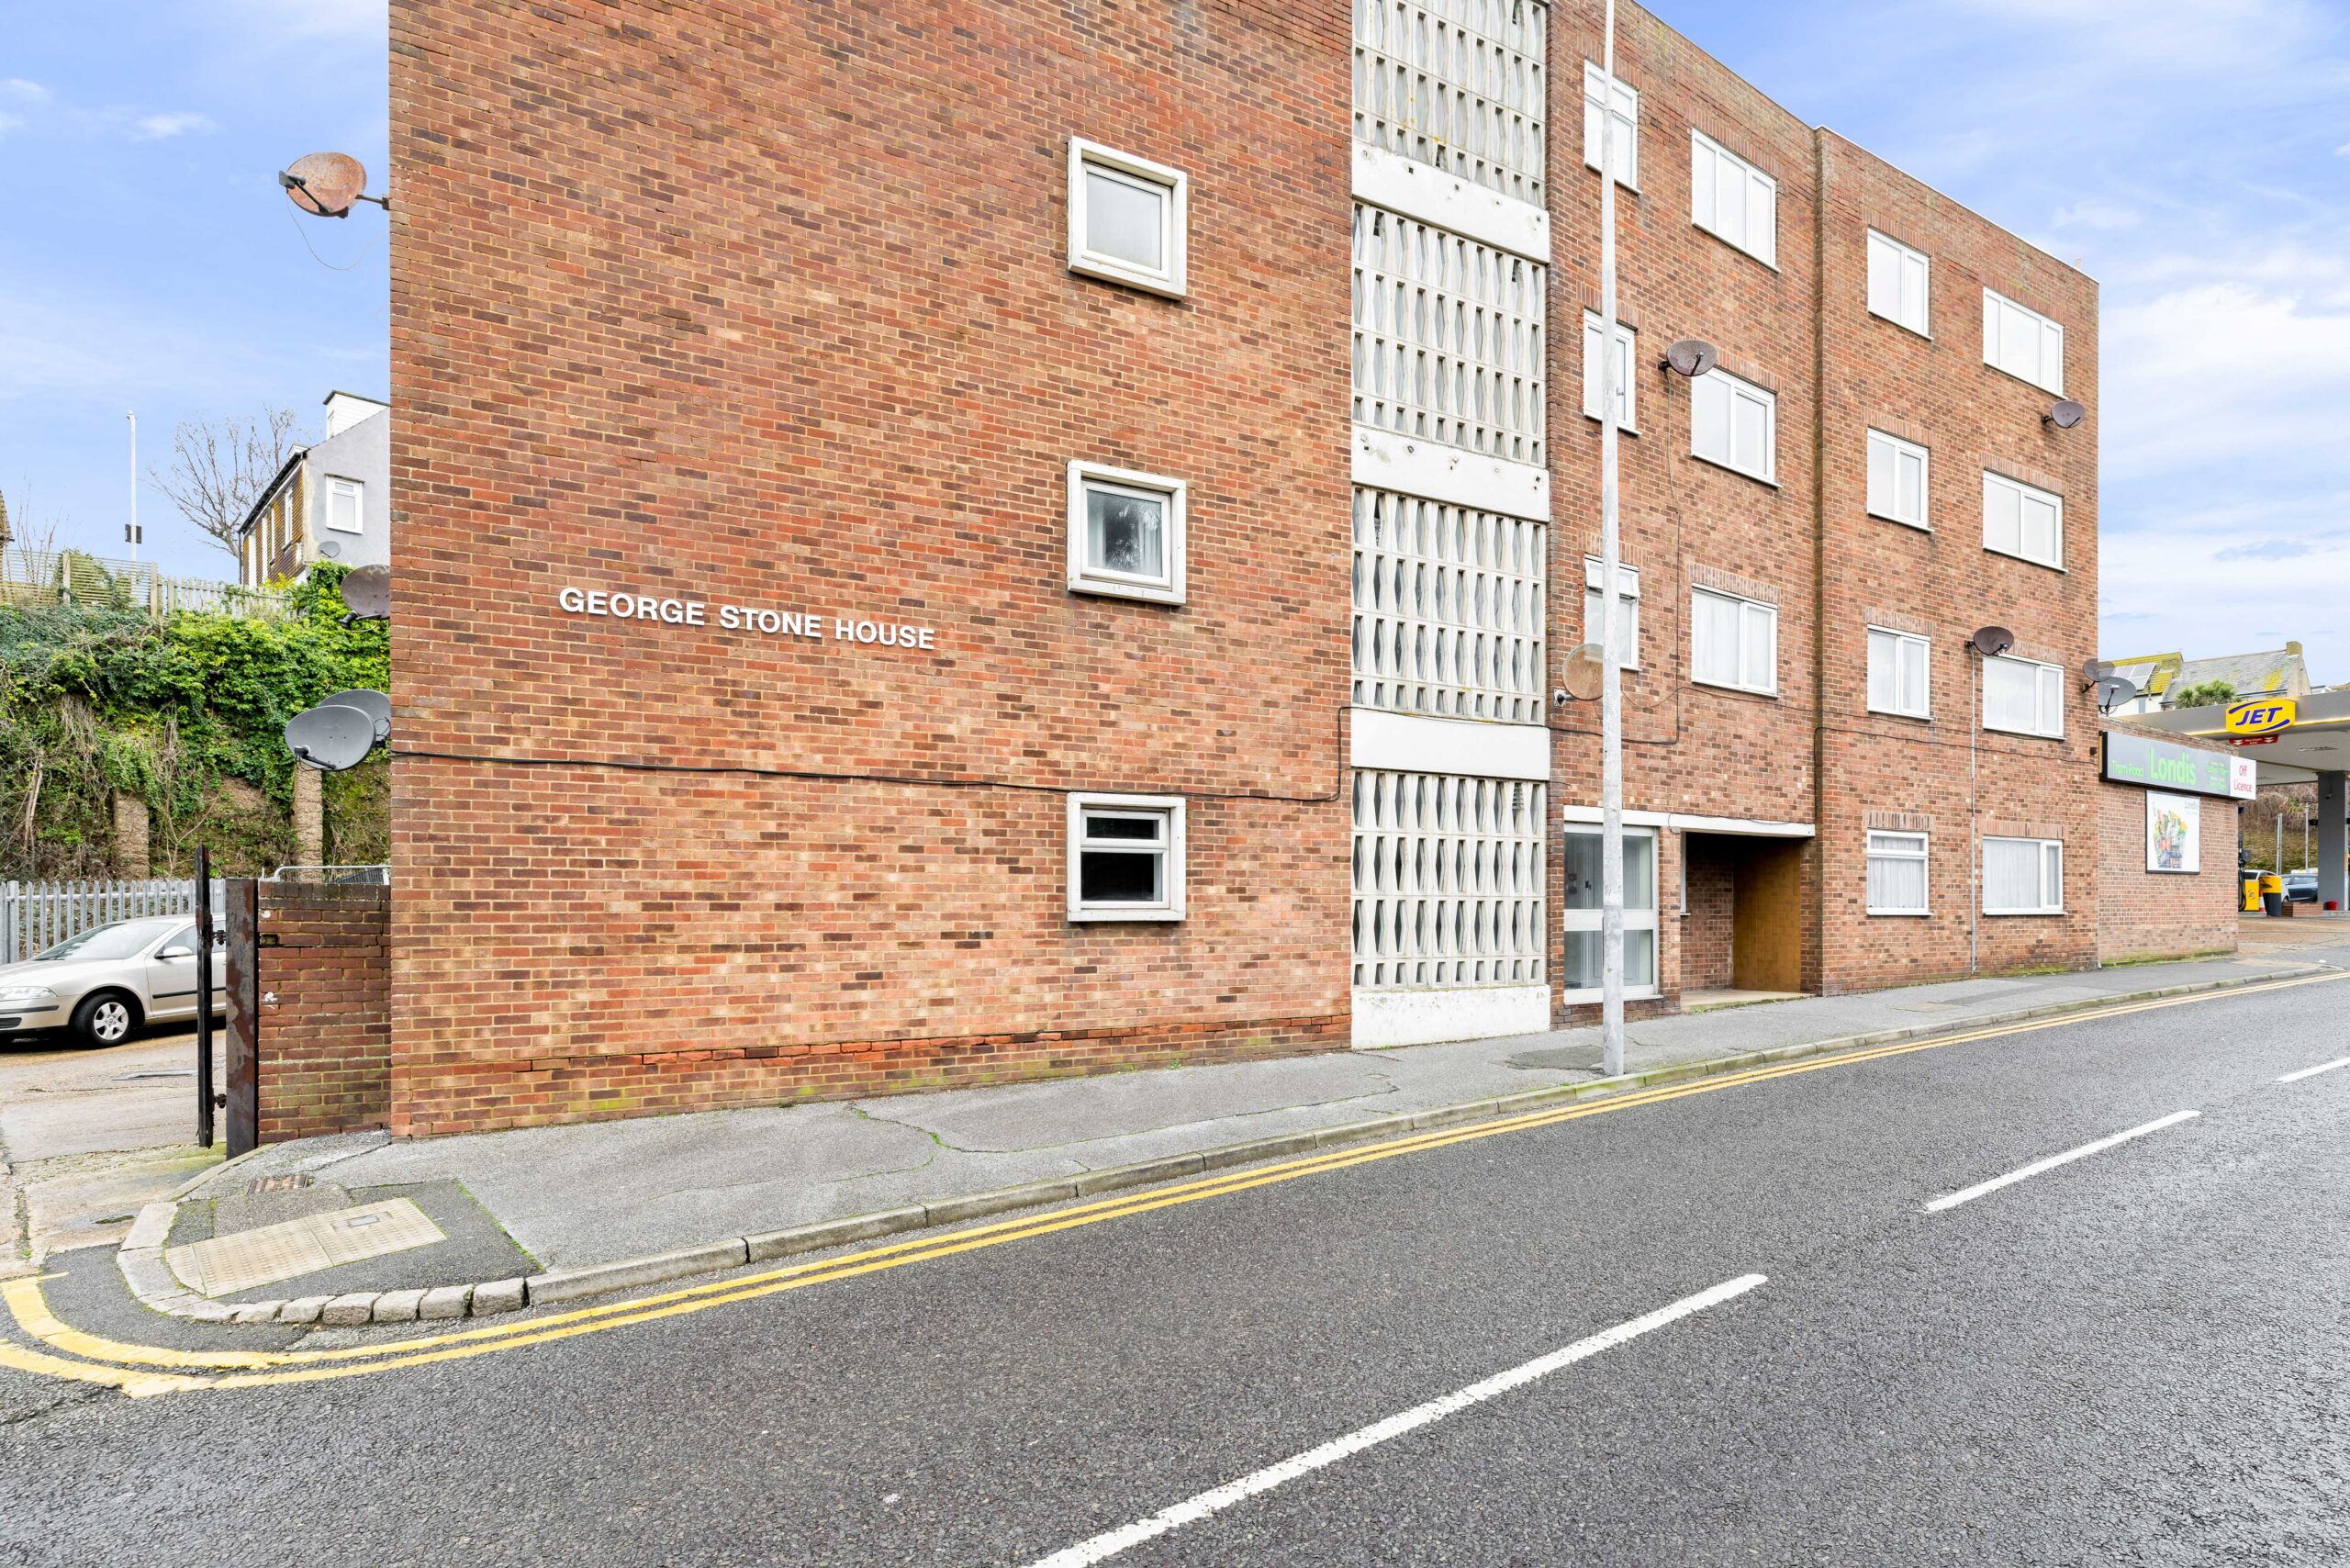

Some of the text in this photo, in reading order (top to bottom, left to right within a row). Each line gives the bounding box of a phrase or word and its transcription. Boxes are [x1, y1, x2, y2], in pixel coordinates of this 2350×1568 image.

[559, 588, 935, 650] GEORGE STONE HOUSE
[2235, 707, 2283, 726] JET
[2149, 747, 2197, 786] Londis
[2239, 765, 2248, 777] Off
[2233, 778, 2253, 792] Licence
